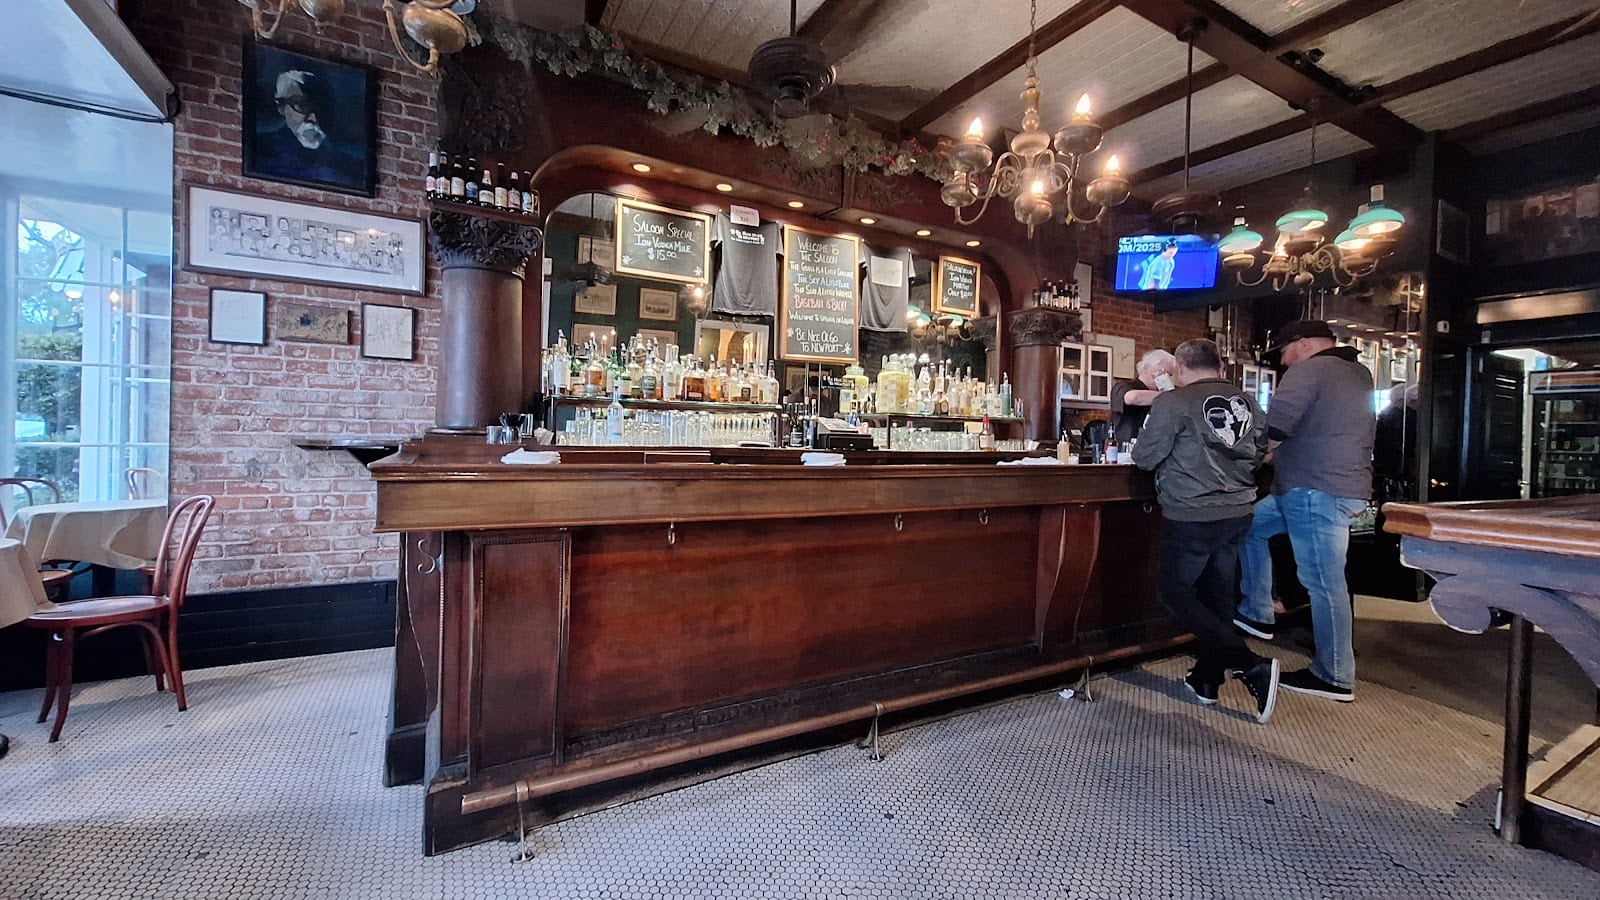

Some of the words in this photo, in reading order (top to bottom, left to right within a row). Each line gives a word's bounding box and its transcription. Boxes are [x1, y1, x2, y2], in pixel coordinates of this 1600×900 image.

[633, 214, 664, 234] SALOON
[667, 222, 696, 242] SPECIAL
[652, 236, 673, 251] VODKA
[798, 236, 829, 253] WELCOME
[830, 244, 839, 255] TO
[799, 250, 812, 261] THE
[814, 252, 838, 264] SALOON
[789, 261, 799, 271] THE
[797, 273, 808, 283] THE
[809, 275, 820, 285] SKY
[820, 277, 825, 285] A
[805, 284, 817, 295] SUN
[817, 286, 822, 296] A
[794, 295, 823, 309] BASEBALL
[826, 299, 831, 309] IS
[795, 328, 805, 341] BE
[829, 332, 838, 343] GO
[800, 341, 809, 352] TO
[811, 342, 843, 352] NEWPORT
